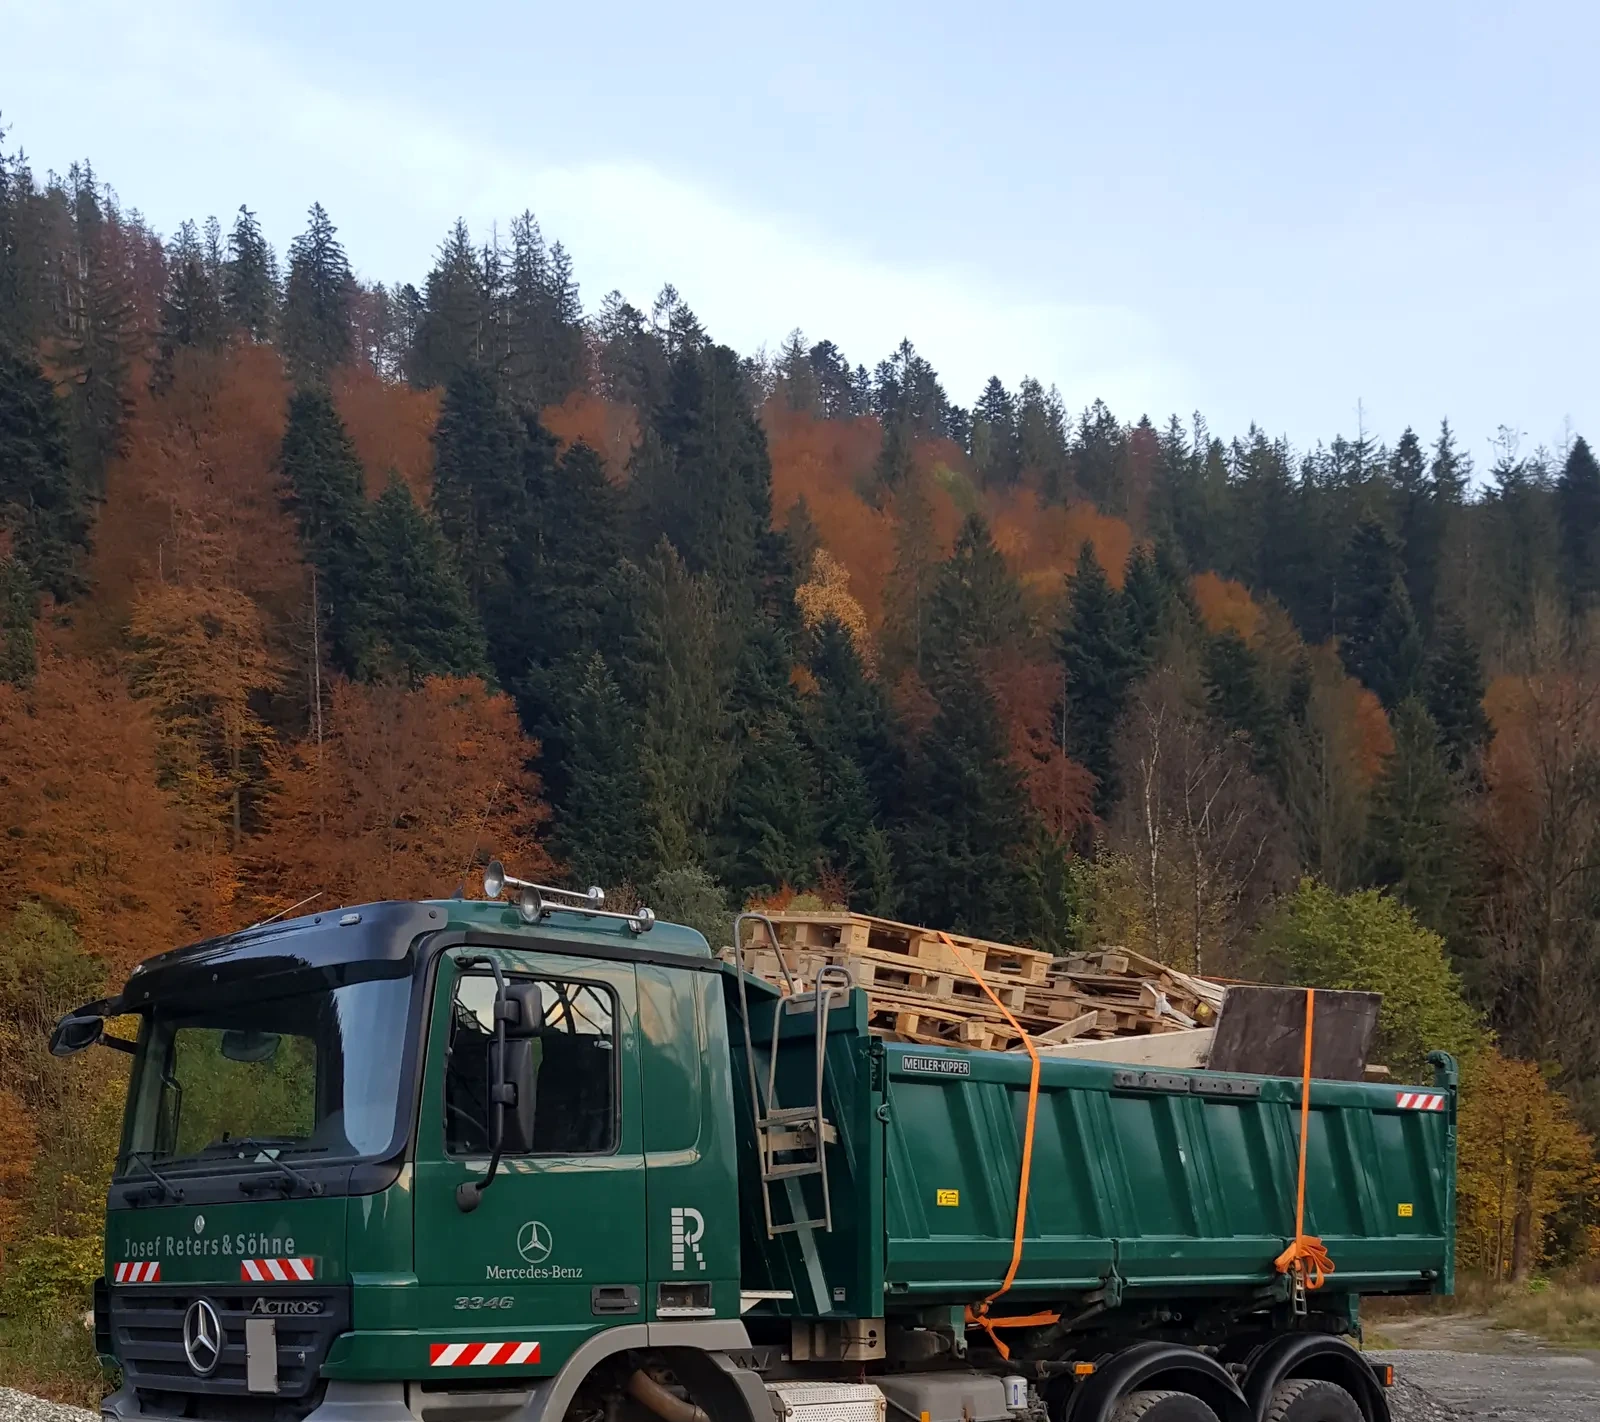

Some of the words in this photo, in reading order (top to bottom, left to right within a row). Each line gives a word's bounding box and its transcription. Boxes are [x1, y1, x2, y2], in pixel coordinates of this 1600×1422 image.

[904, 1058, 968, 1073] MEILLER-KIPPER
[124, 1236, 161, 1258] Josef
[485, 1265, 583, 1280] Mercedes-Benz
